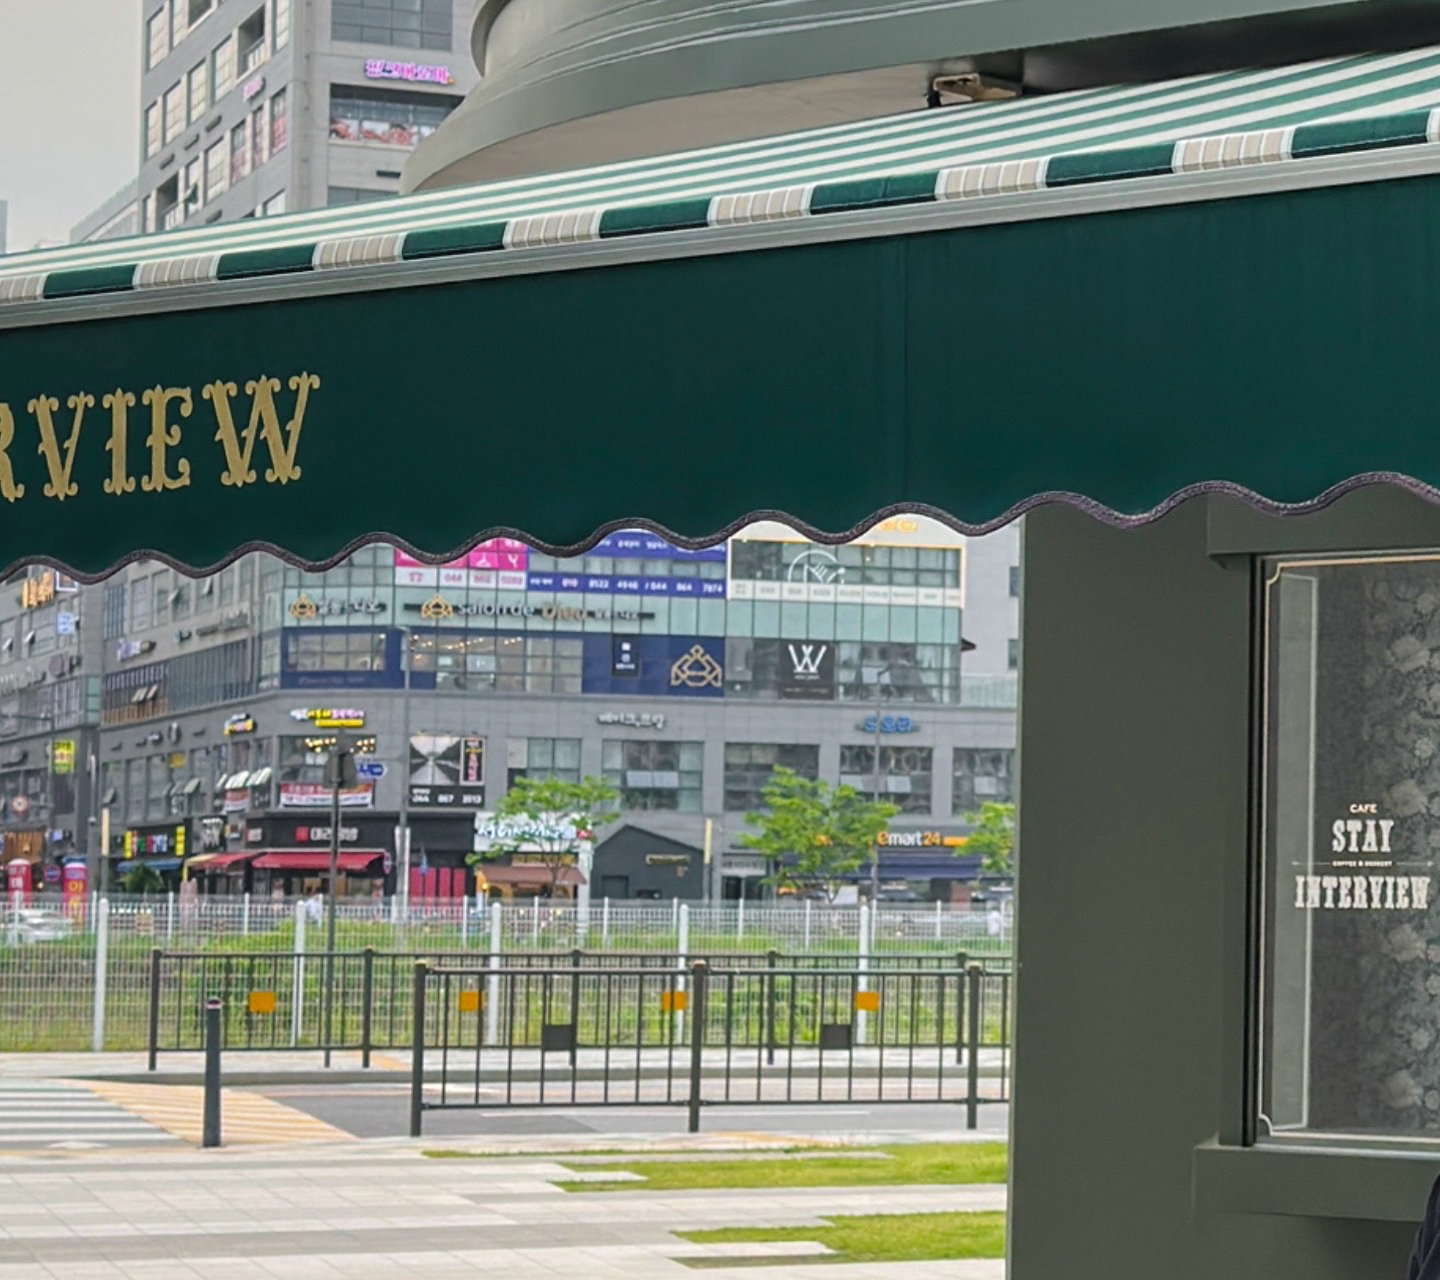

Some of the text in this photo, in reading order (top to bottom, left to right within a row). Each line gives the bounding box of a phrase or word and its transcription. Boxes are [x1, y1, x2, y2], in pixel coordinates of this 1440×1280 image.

[1349, 803, 1378, 814] CAFE
[877, 831, 941, 847] emart24
[1332, 819, 1395, 853] STAY
[1294, 875, 1431, 910] INTERVIEW
